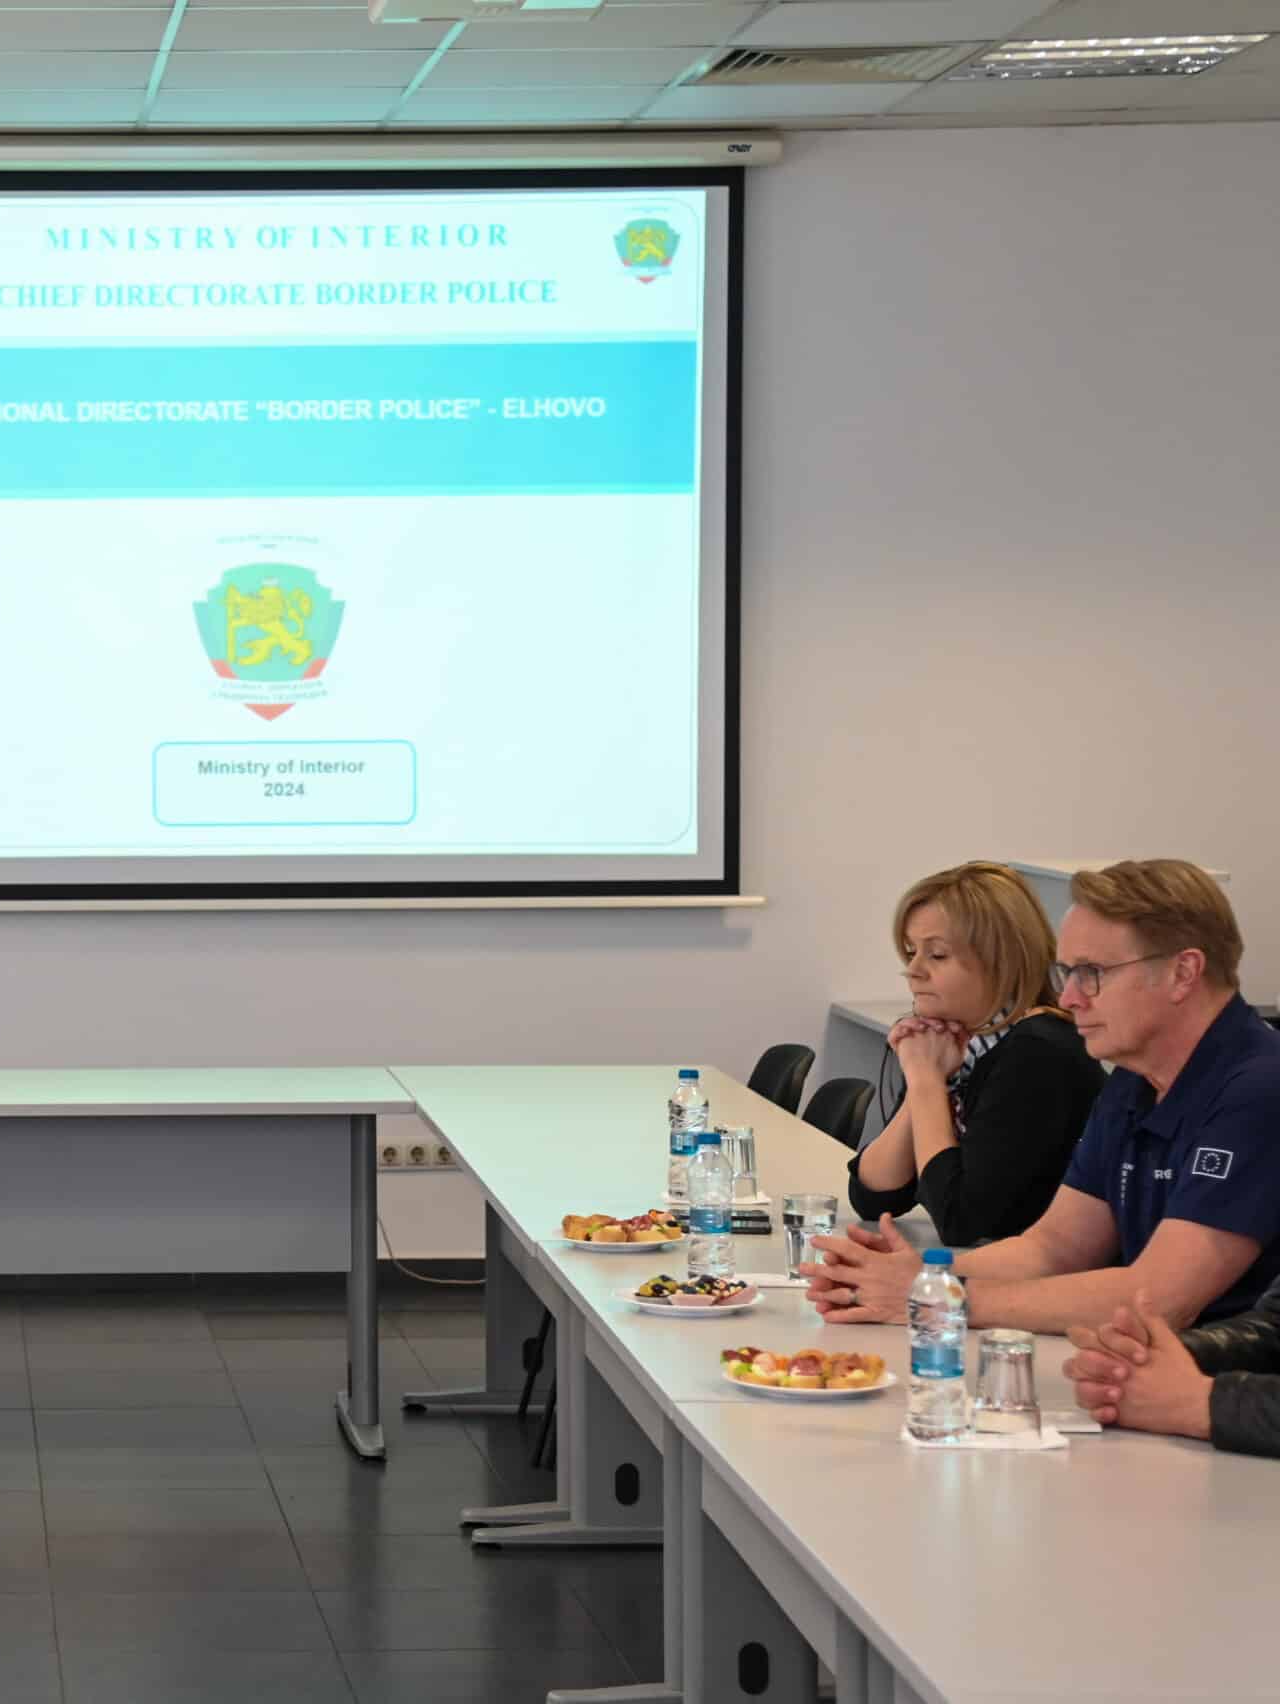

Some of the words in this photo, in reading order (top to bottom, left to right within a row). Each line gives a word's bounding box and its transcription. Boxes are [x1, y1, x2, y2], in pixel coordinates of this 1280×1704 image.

[46, 225, 242, 251] MINISTRY
[255, 224, 297, 250] OF
[311, 222, 509, 249] INTERIOR
[94, 282, 306, 307] DIRECTORATE
[315, 281, 439, 306] BORDER
[446, 279, 560, 304] POLICE
[76, 399, 249, 423] DIRECTORATE
[502, 396, 607, 419] ELHOVO
[197, 759, 271, 777] Ministry
[275, 759, 295, 774] of
[299, 759, 366, 775] Interior
[263, 782, 306, 797] 2024
